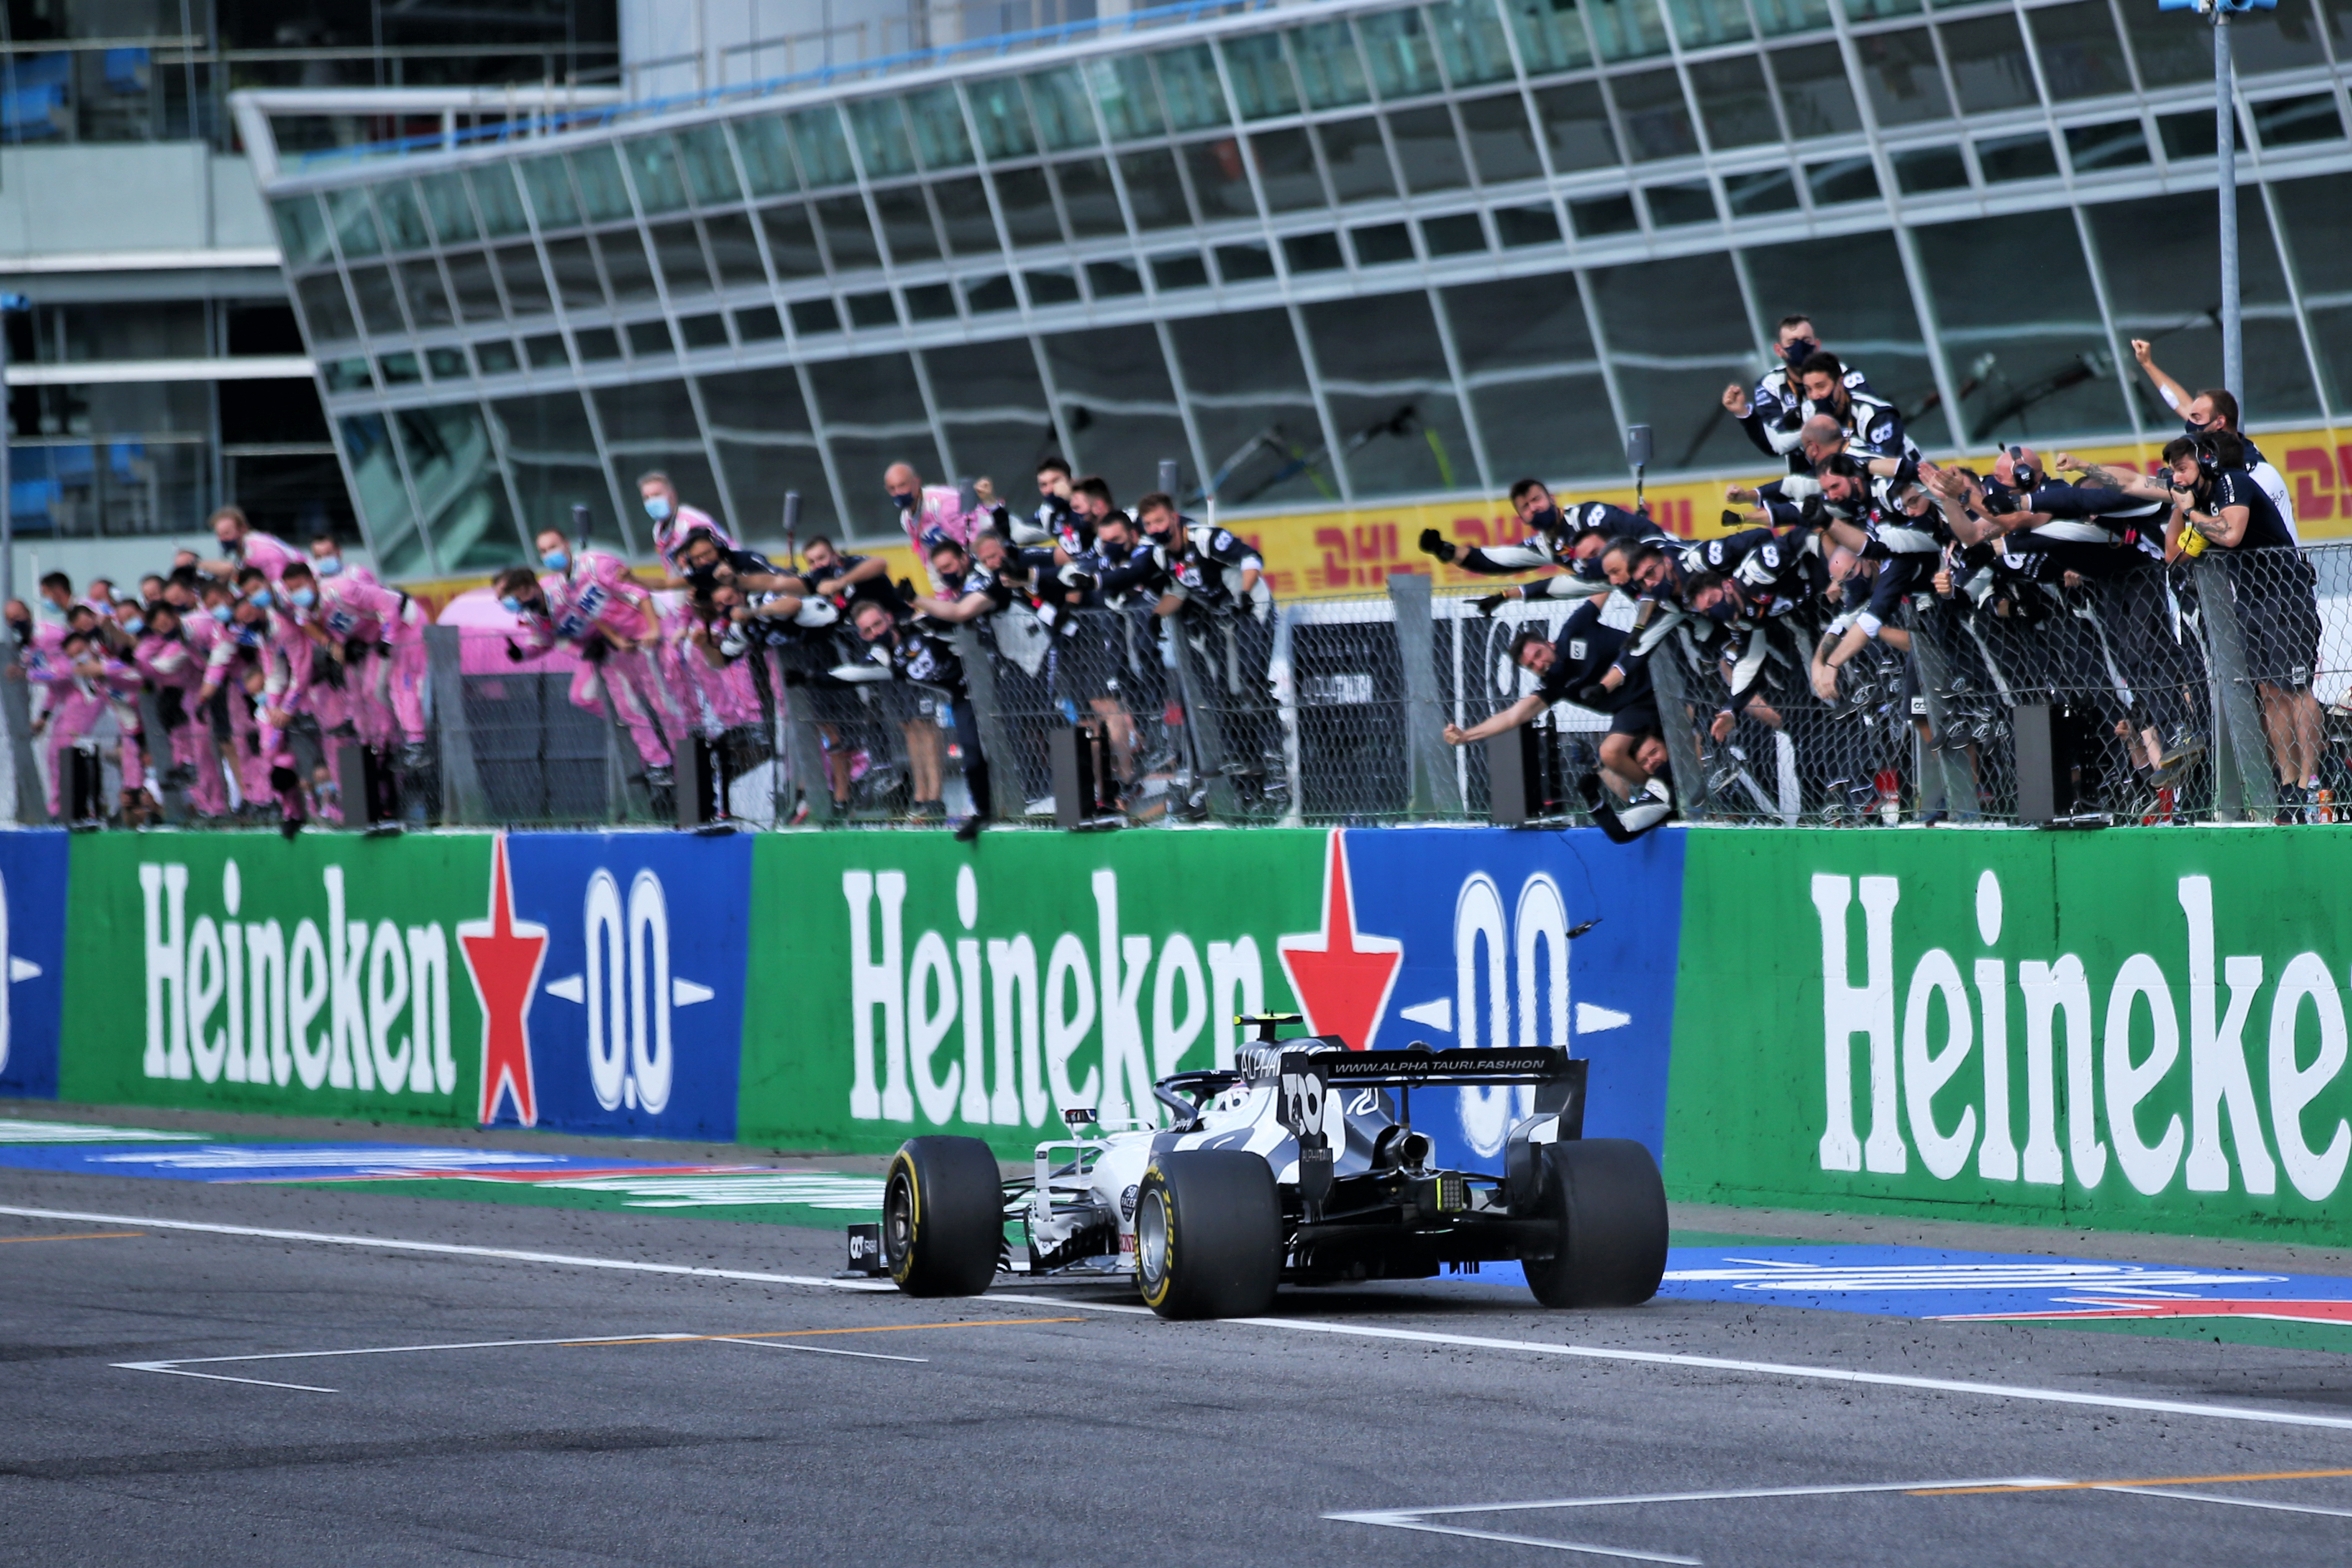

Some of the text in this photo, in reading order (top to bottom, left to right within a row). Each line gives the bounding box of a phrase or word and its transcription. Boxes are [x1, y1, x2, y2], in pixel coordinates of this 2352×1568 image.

[139, 858, 456, 1095] Heineken
[842, 864, 1265, 1126] Heineken
[1335, 1059, 1545, 1073] WWW.ALPHA TAURI.FASHION
[1811, 869, 2352, 1202] Heineke
